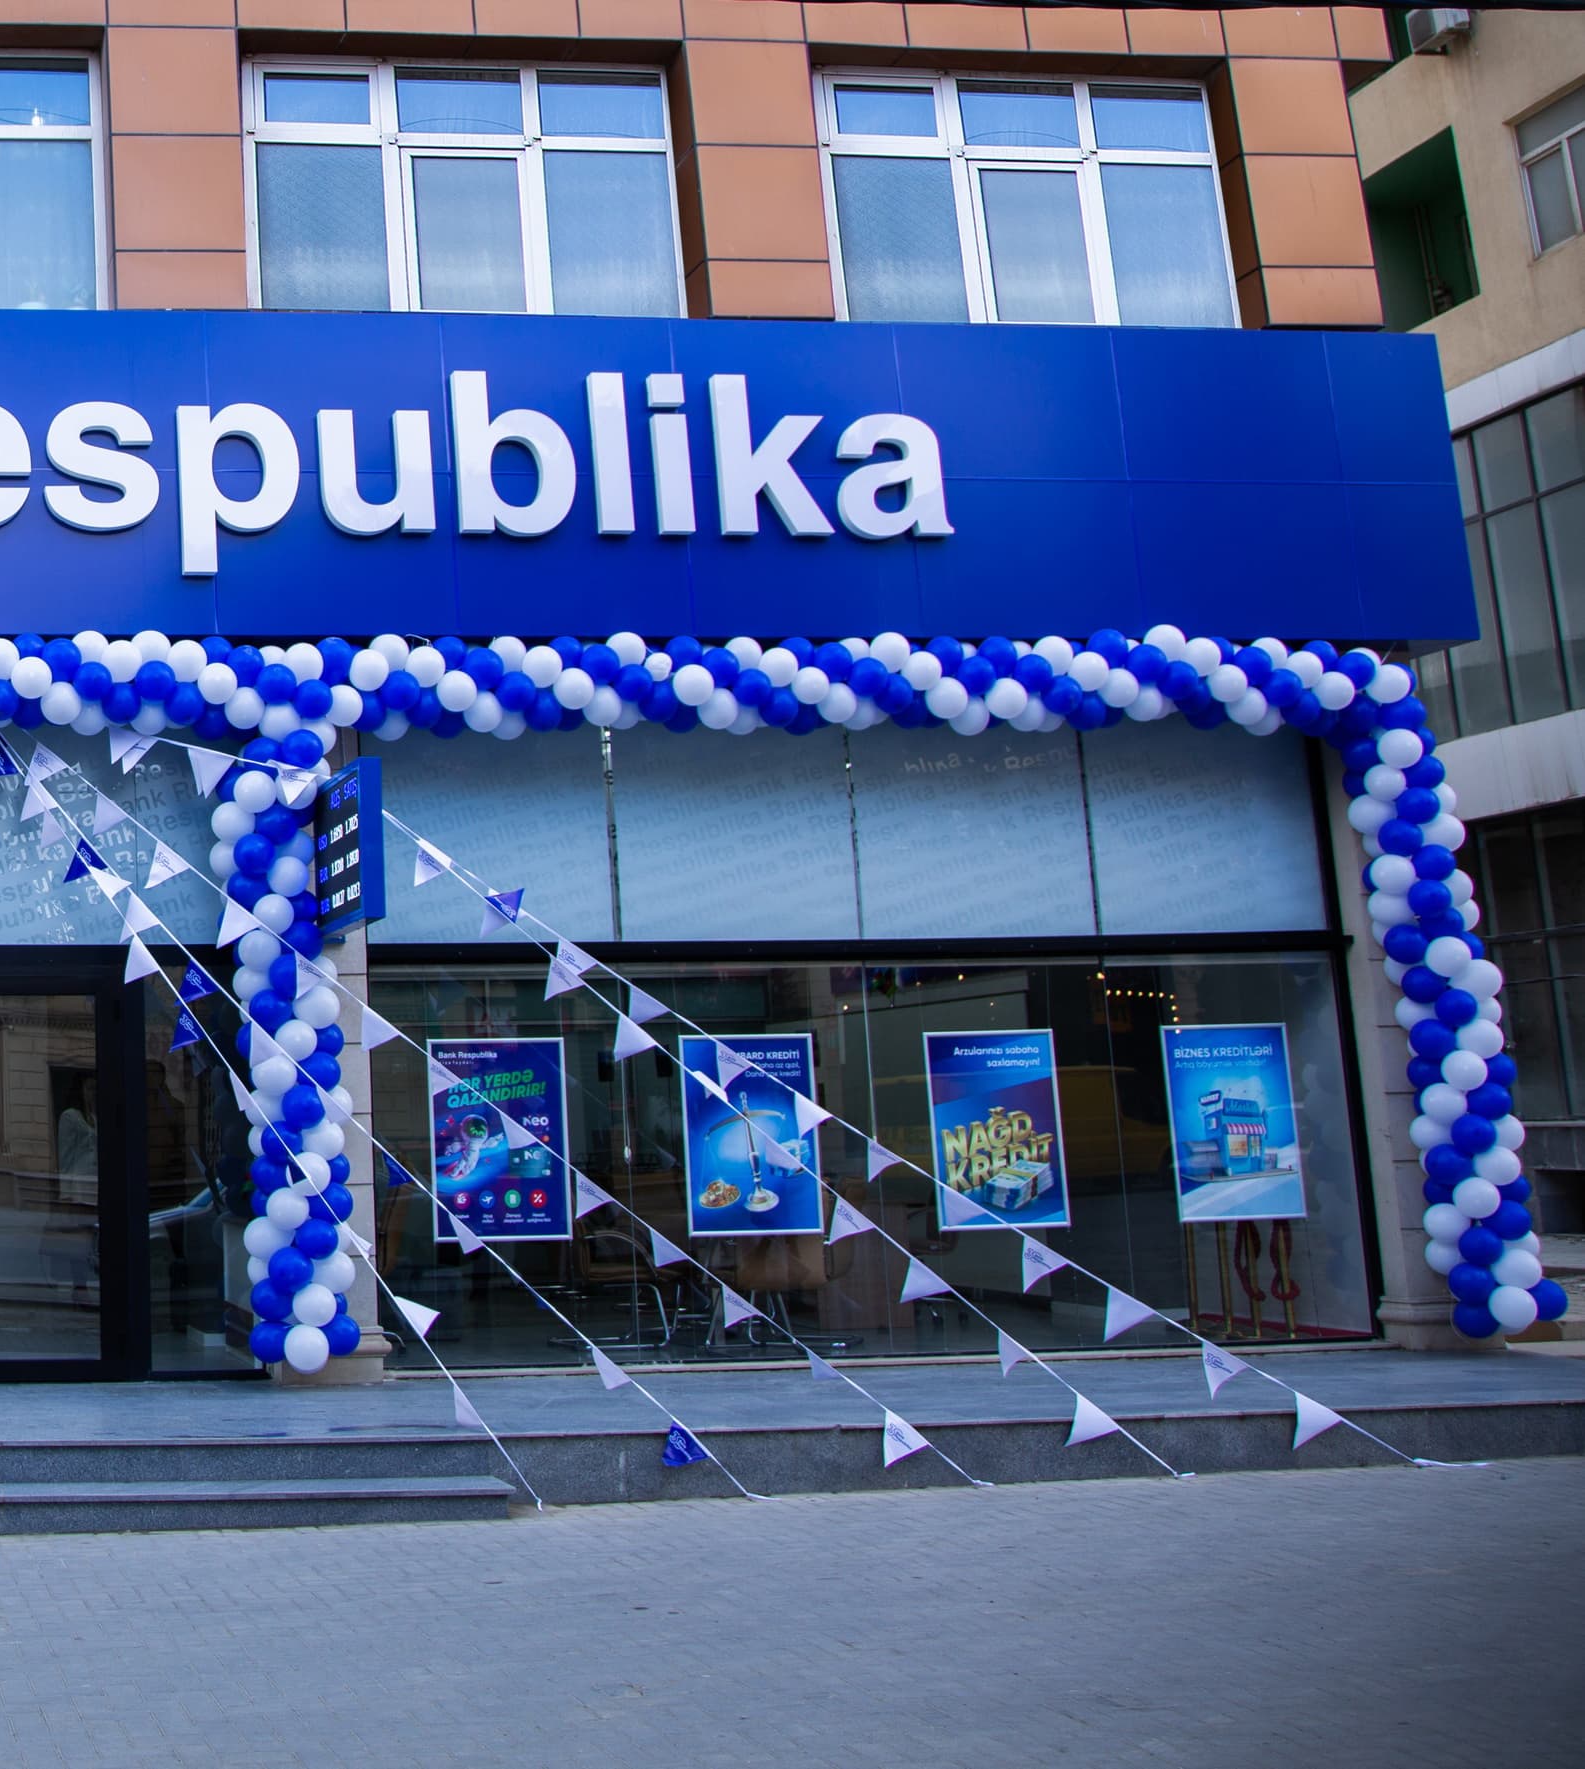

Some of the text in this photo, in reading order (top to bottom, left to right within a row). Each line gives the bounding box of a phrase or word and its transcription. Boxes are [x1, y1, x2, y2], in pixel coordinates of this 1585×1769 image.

[724, 774, 787, 804] Bank
[438, 1050, 498, 1061] Bank Respublika
[736, 1049, 800, 1060] MBARD KREDİTİ
[1174, 1043, 1273, 1059] BİZNES KREDİTLƏRİ
[483, 1068, 534, 1089] YERDƏ
[941, 1106, 1033, 1164] NAĞD
[946, 1131, 1055, 1191] KREDİT
